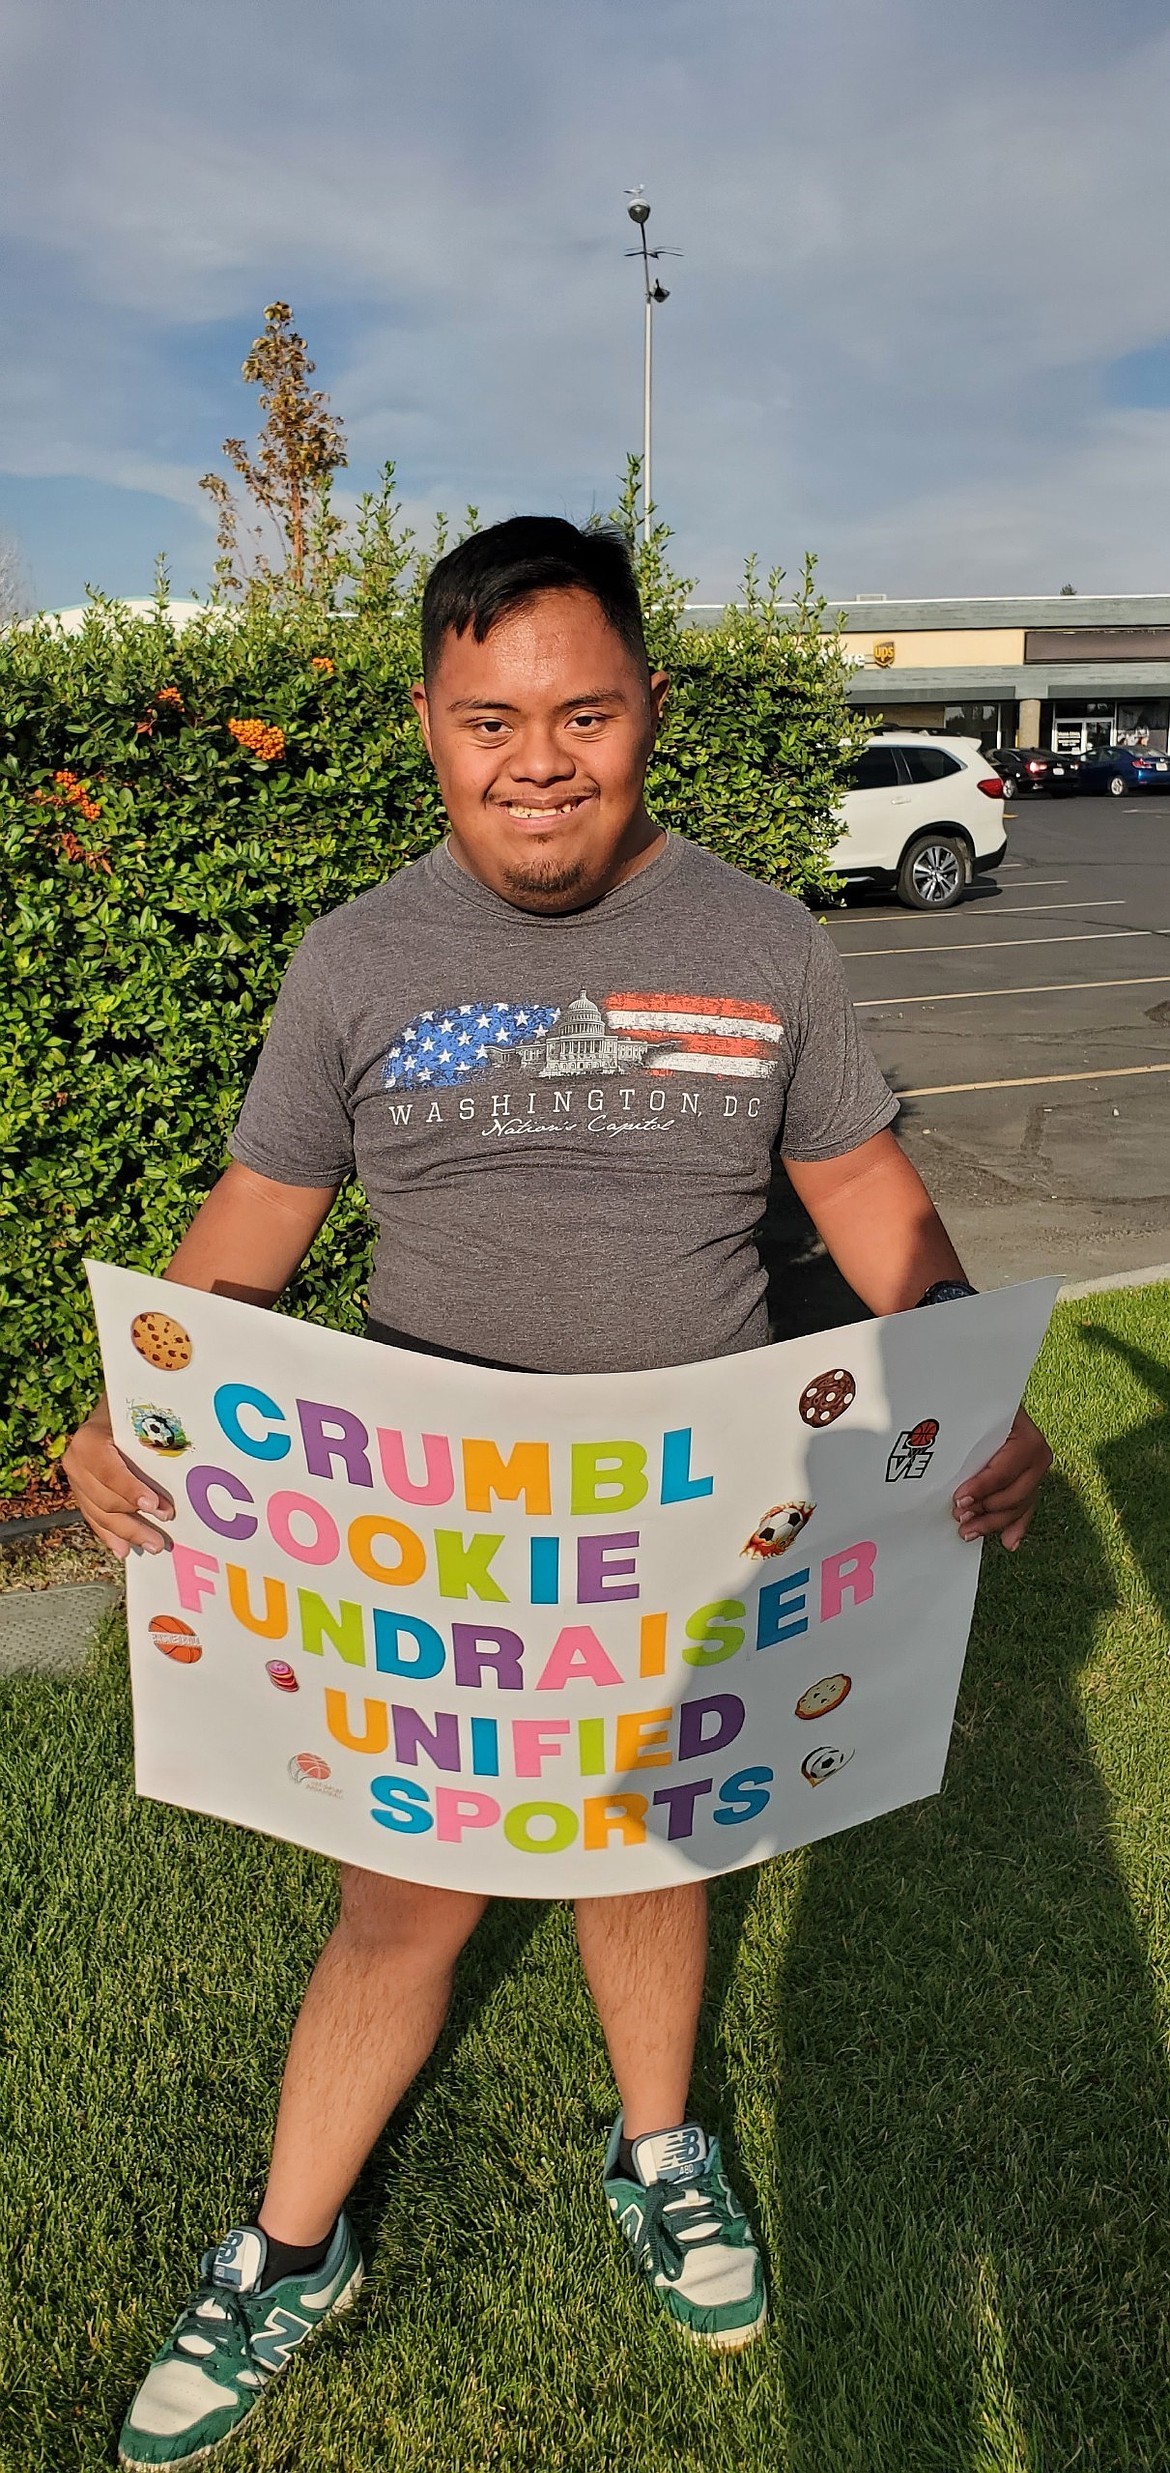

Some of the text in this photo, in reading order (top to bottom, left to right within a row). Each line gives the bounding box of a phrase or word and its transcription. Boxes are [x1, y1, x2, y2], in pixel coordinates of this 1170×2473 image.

[388, 1089, 760, 1126] WASHINGTON, DC
[481, 1118, 577, 1137] Nation's
[213, 1383, 714, 1516] CRUMBL
[185, 1465, 641, 1605] COOKIE
[172, 1541, 877, 1691] FUNDRAISER
[323, 1687, 746, 1779] UNIFIED
[370, 1765, 773, 1854] SPORTS
